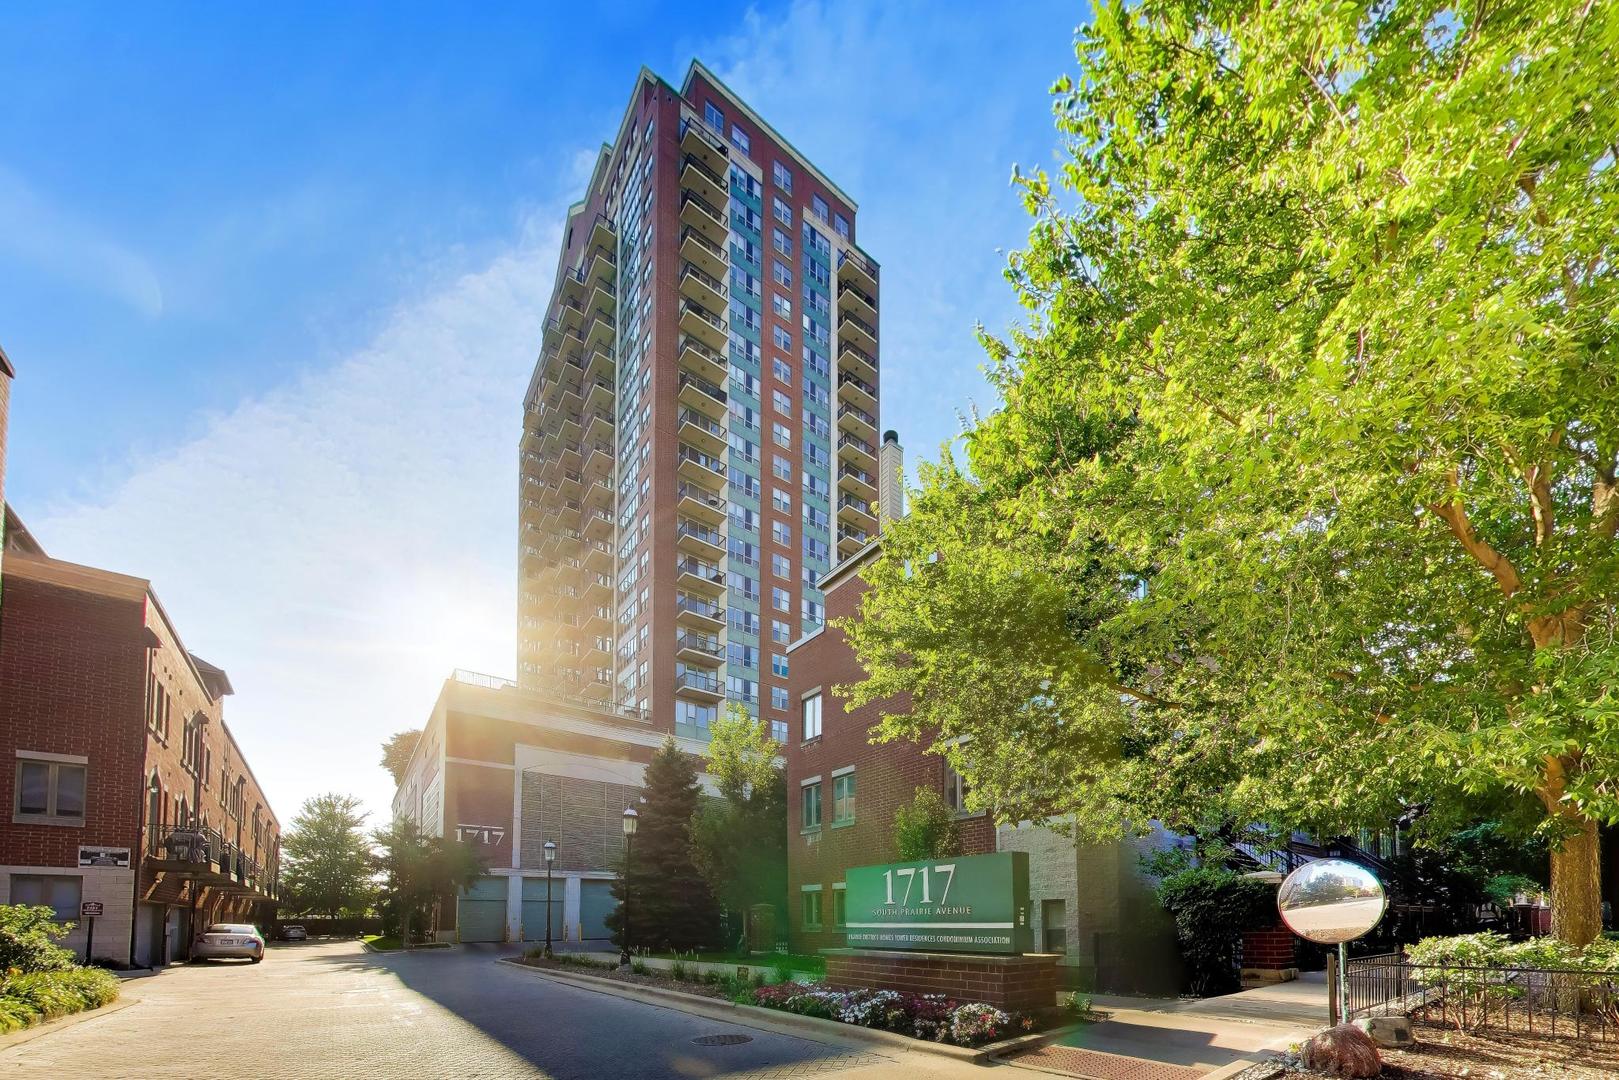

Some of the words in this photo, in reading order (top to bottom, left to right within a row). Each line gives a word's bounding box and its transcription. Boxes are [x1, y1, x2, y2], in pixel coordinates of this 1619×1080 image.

[455, 829, 505, 846] 1717
[883, 864, 956, 906] 1717
[872, 908, 897, 916] SOUTH
[900, 907, 932, 915] PRAIRIE
[936, 906, 972, 915] AVENUE
[910, 934, 935, 942] RESIDENCES
[936, 935, 973, 943] CONDOMINIUM
[974, 936, 1011, 944] ASSOCIATION
